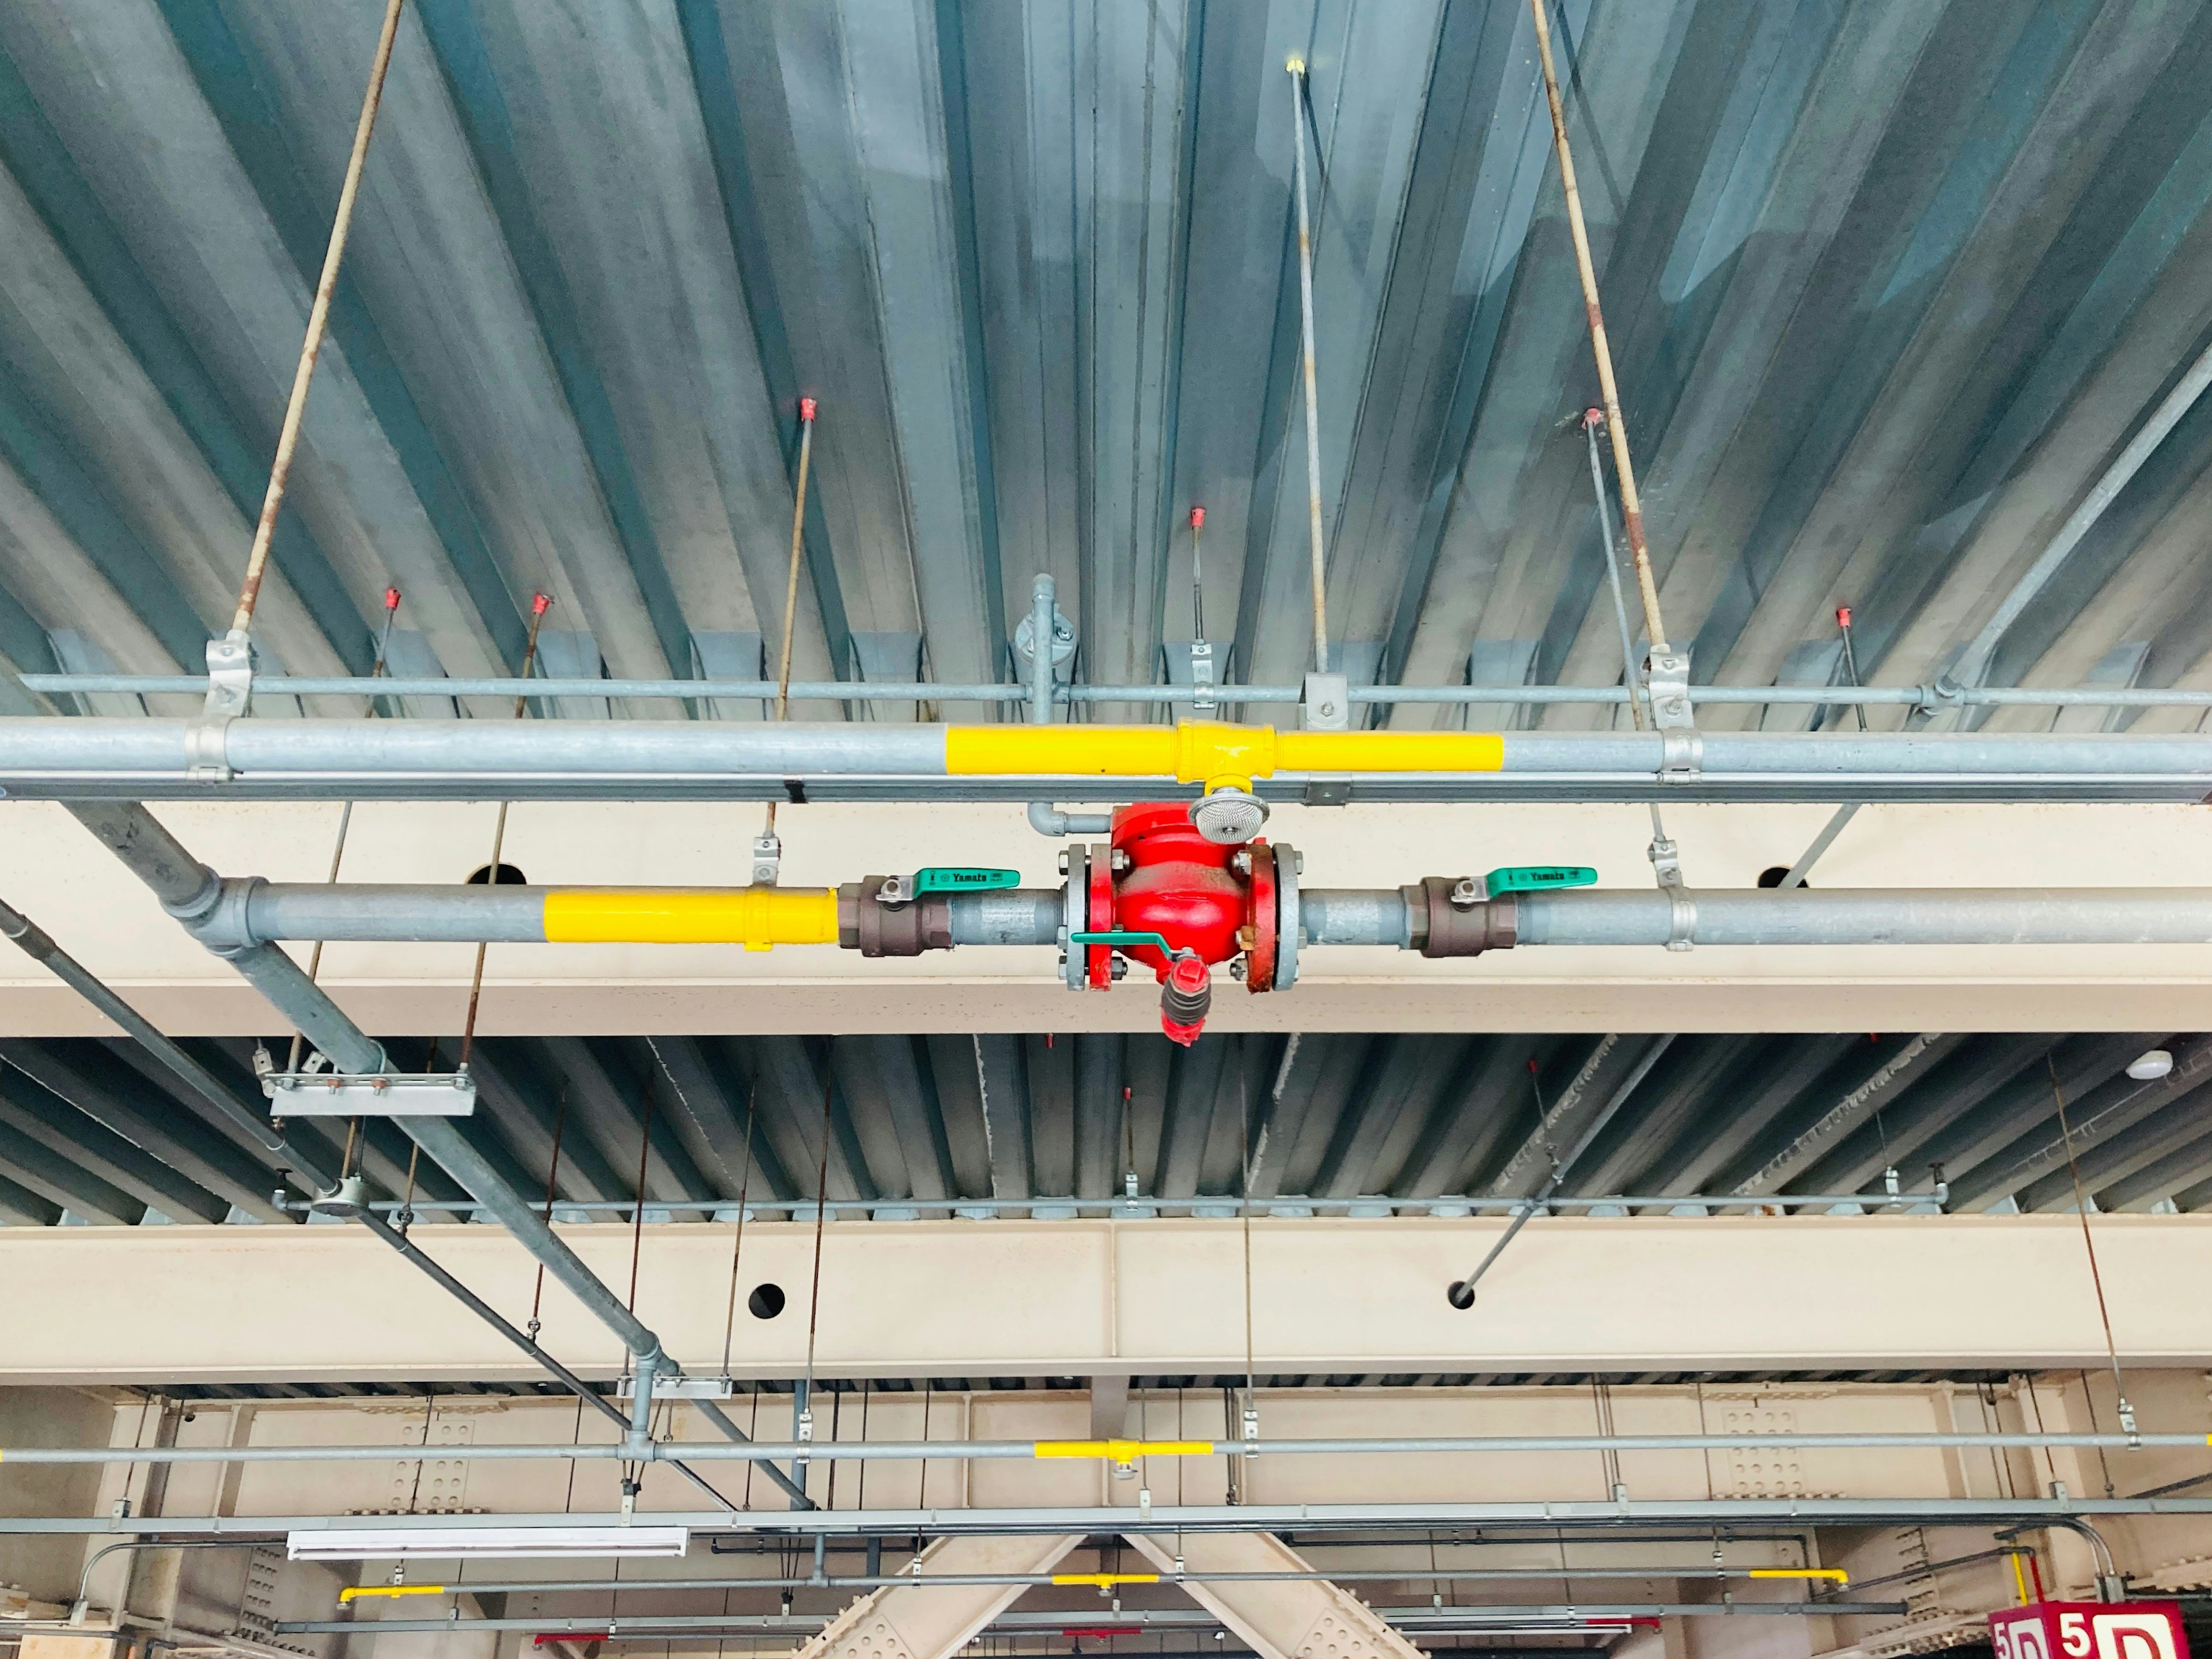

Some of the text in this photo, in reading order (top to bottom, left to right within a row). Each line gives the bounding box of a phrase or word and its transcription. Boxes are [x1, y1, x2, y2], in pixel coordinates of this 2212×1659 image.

[953, 873, 987, 882] Yamato
[1531, 872, 1564, 881] Yamato
[1994, 1622, 2010, 1659] 5
[2060, 1613, 2091, 1657] 5
